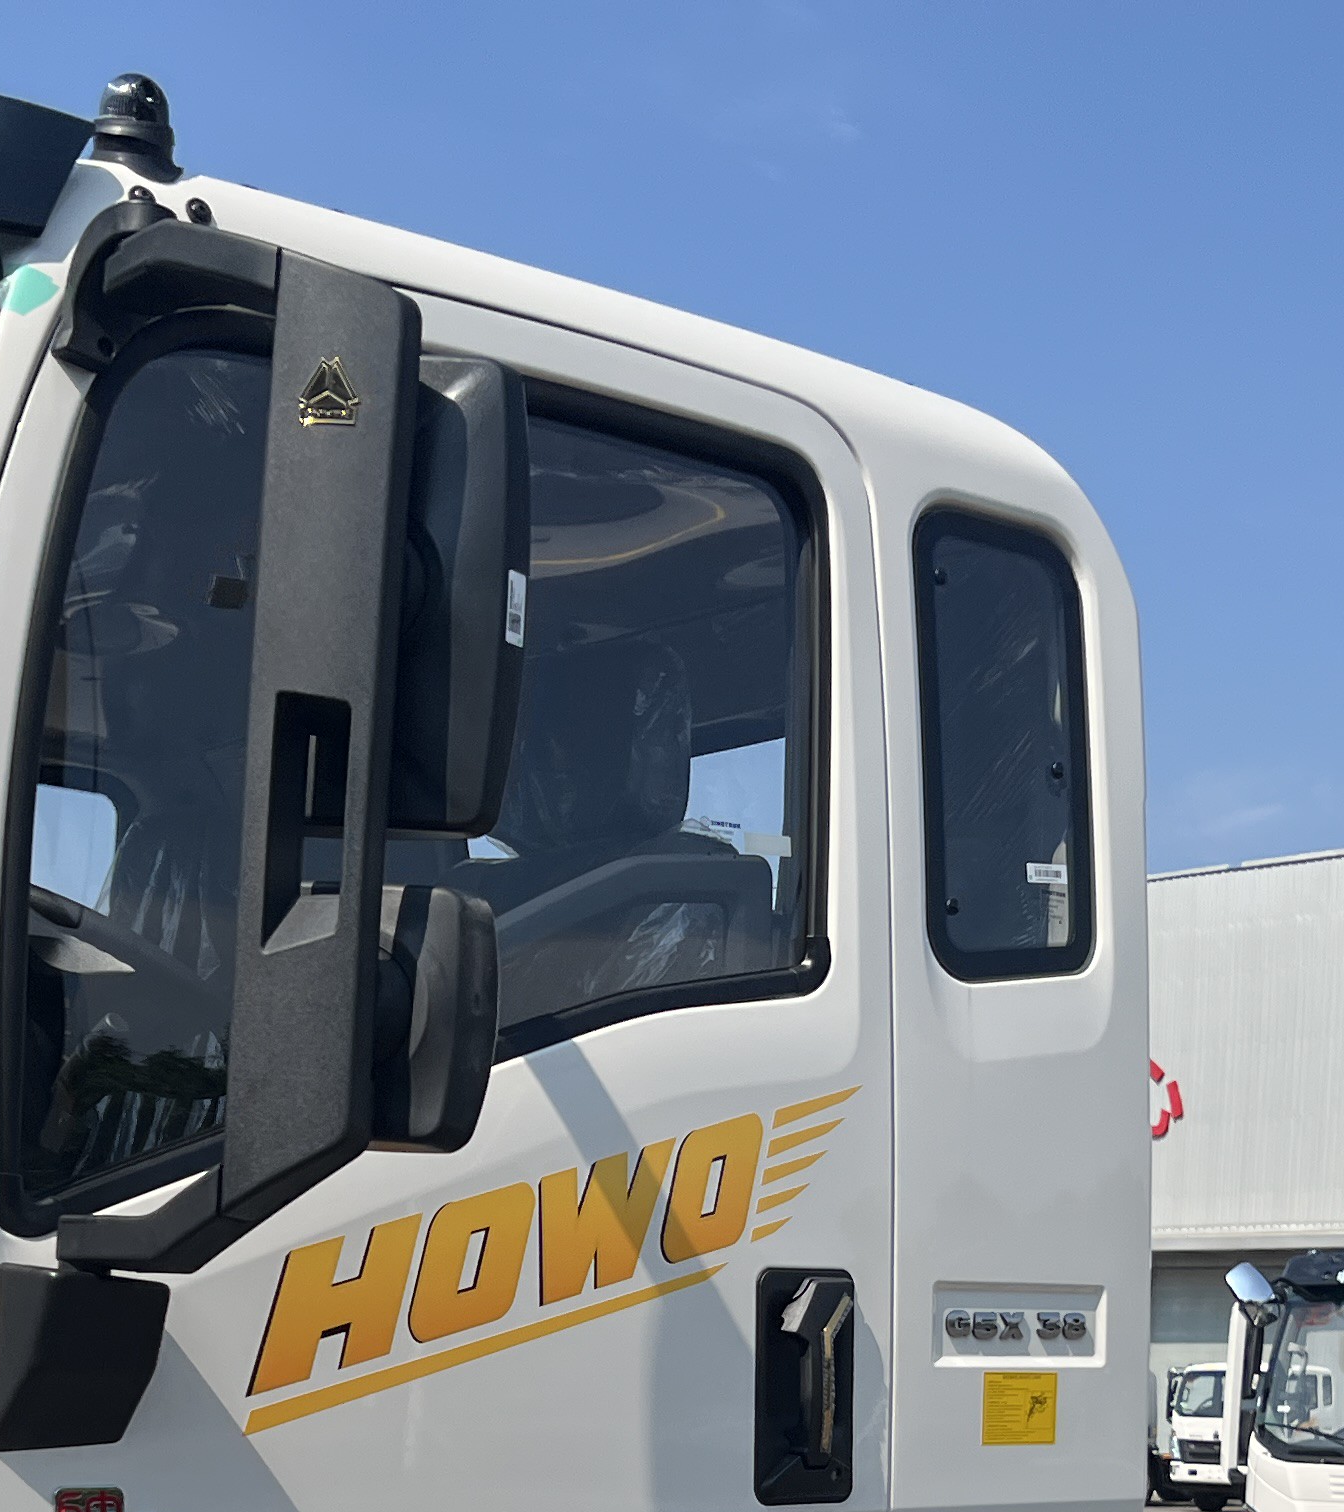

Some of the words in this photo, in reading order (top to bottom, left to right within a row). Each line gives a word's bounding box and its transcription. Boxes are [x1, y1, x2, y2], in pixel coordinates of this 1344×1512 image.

[246, 1112, 763, 1398] HOWO
[945, 1309, 1025, 1341] G5X
[1036, 1311, 1087, 1341] 38
